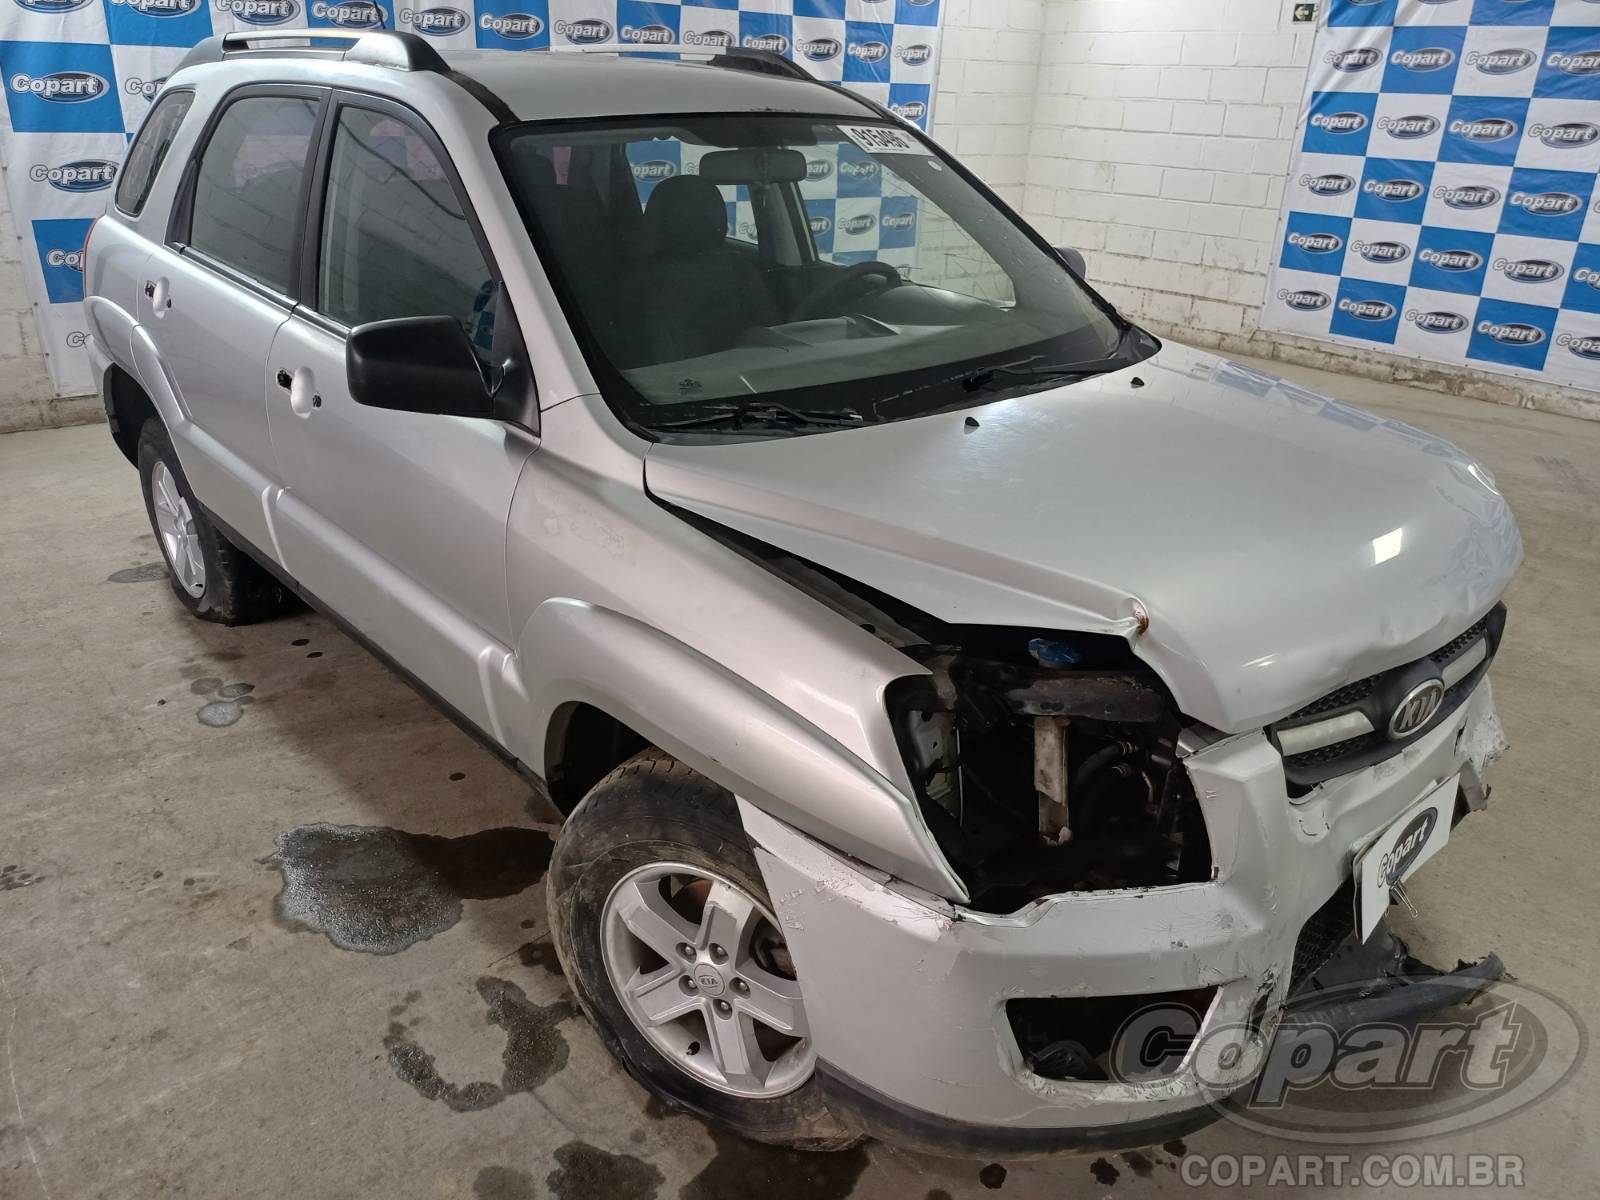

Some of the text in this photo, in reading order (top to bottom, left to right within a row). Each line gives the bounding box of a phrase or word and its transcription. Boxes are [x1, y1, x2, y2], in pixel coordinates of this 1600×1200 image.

[111, 0, 190, 11] part
[312, 3, 378, 23] Copart
[399, 8, 462, 29] Copart
[479, 13, 537, 33] Copart
[554, 20, 605, 39] Copart
[621, 25, 669, 43] Copart
[683, 30, 730, 46] Copart
[743, 35, 784, 50] Copart
[796, 39, 836, 55] Copart
[848, 43, 883, 59] Copart
[894, 46, 929, 61] Copart
[1324, 50, 1376, 67] Copart
[1391, 50, 1447, 67] Copart
[1465, 51, 1526, 69] Copart
[11, 74, 99, 97] Copart
[1311, 113, 1361, 130] Copart
[1377, 116, 1431, 133] Copart
[1450, 120, 1509, 137] Copart
[1528, 124, 1593, 142] Copart
[30, 164, 113, 185] Copart
[631, 163, 671, 179] opart
[1300, 174, 1348, 192] Copart
[1363, 179, 1417, 199] Copart
[1433, 186, 1492, 205] Copart
[1509, 192, 1575, 212] Copart
[1287, 232, 1336, 251] Copart
[1351, 240, 1403, 260] Copart
[1419, 249, 1476, 269] Copart
[1493, 258, 1557, 280] Copart
[1277, 289, 1325, 307] Copart
[1338, 299, 1390, 318] Copart
[1405, 309, 1462, 329] Copart
[1477, 320, 1539, 343] Copart
[1400, 689, 1437, 731] KIA
[1377, 816, 1430, 889] Copart
